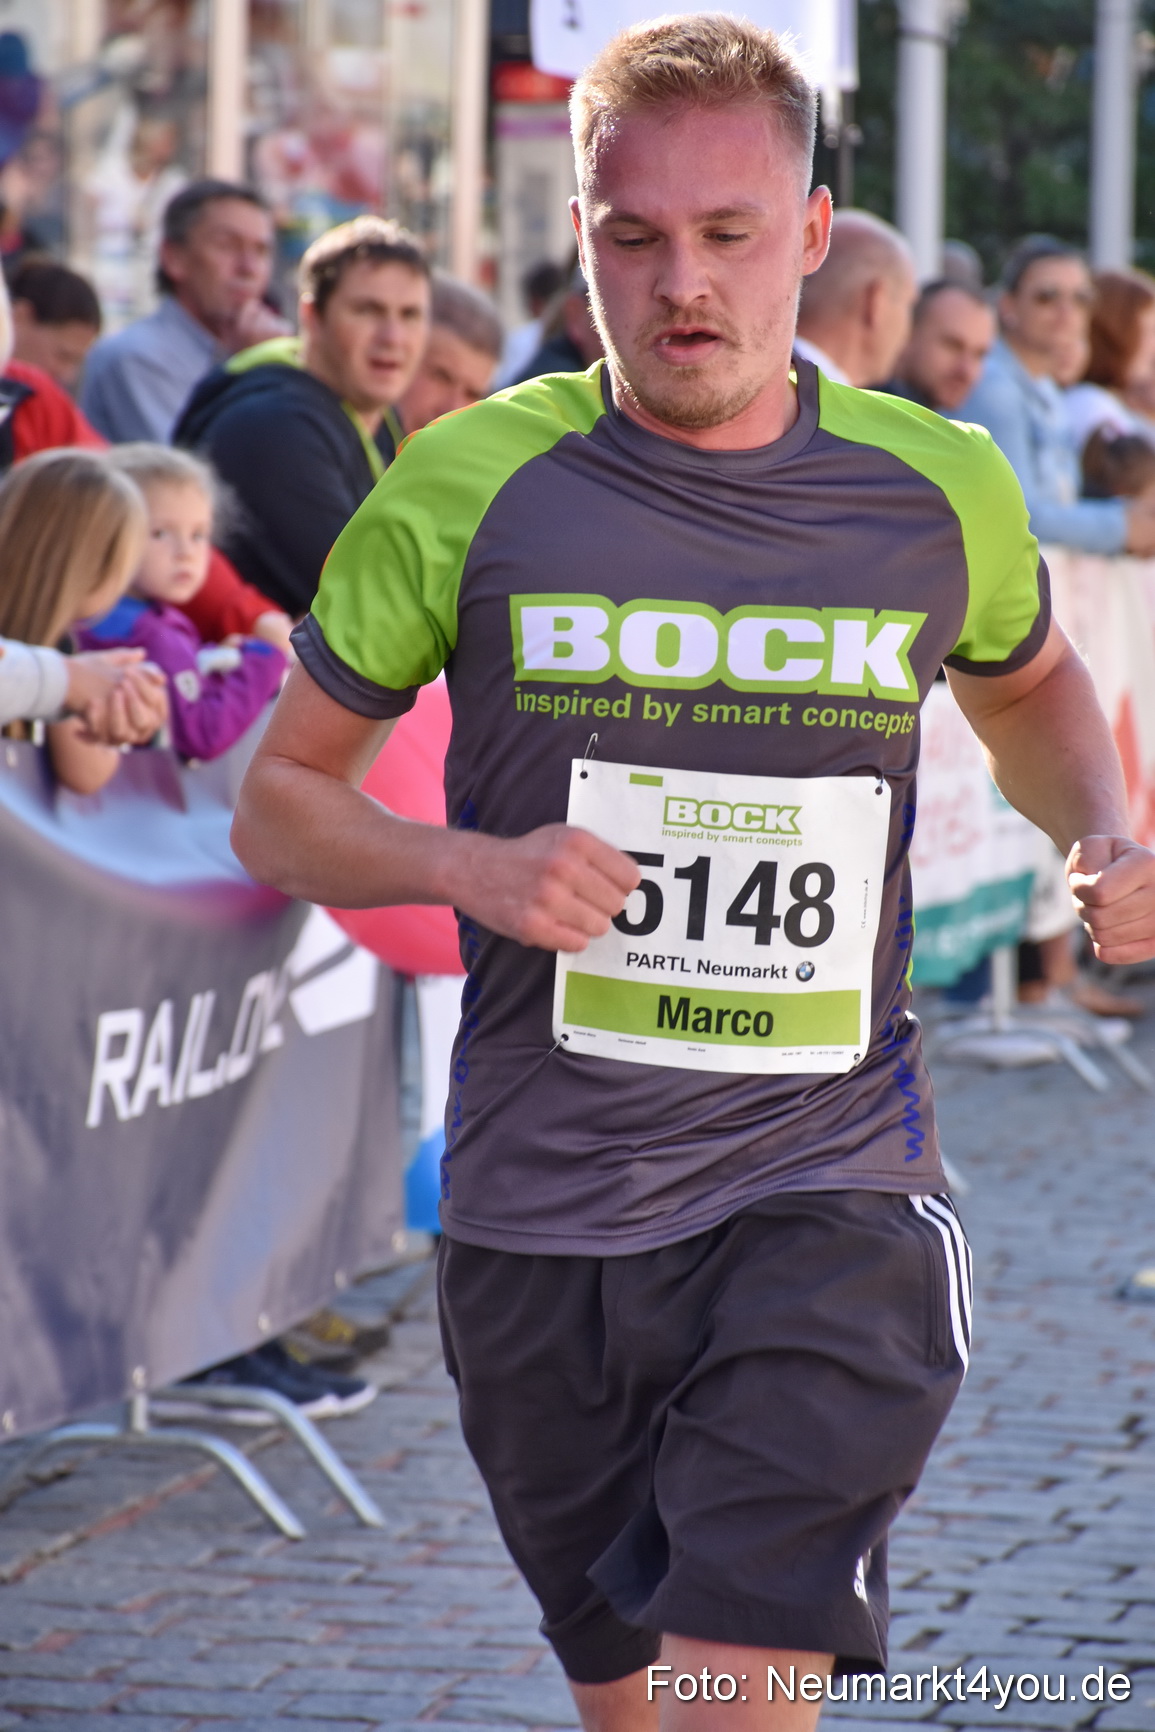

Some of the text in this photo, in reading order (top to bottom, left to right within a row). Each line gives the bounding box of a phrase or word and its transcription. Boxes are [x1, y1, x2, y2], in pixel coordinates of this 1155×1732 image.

[515, 601, 918, 695] BOCK
[515, 687, 916, 739] inspired by smart concepts
[665, 797, 800, 834] BOCK
[662, 827, 803, 848] inspired by smart concepts
[611, 850, 836, 948] 5148
[626, 951, 691, 973] PARTL
[697, 959, 788, 980] Neumarkt
[656, 994, 774, 1037] Marco
